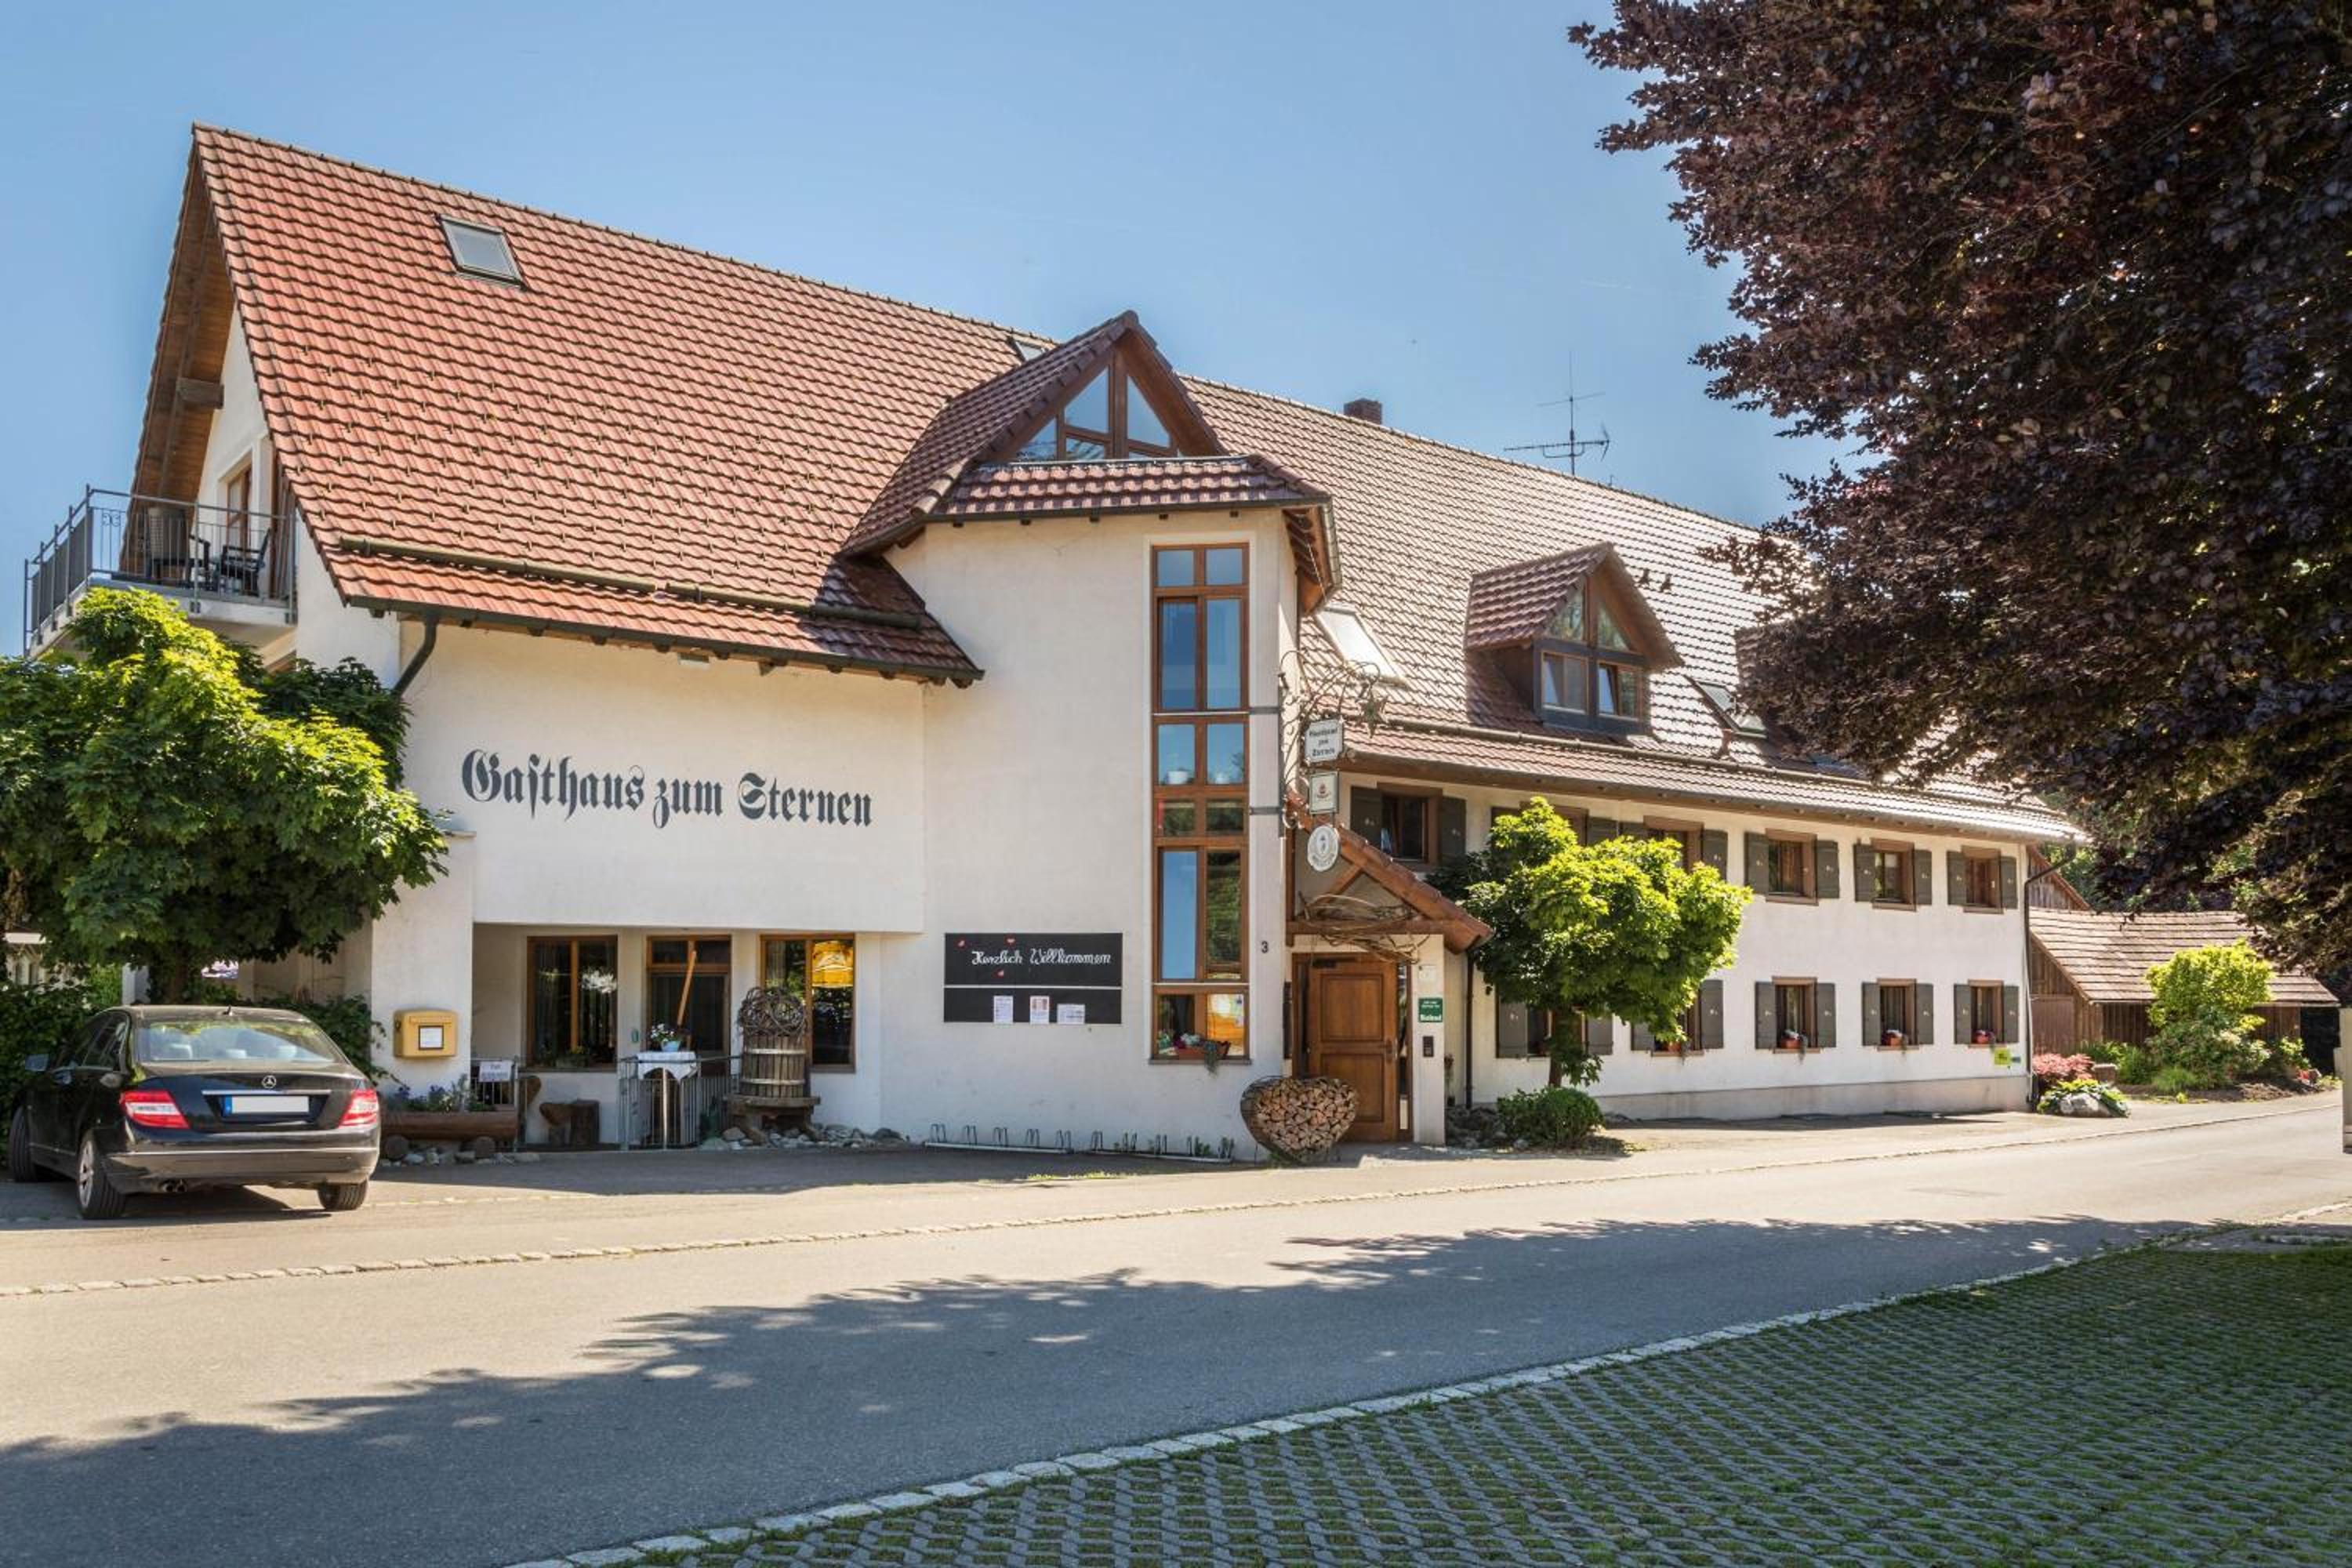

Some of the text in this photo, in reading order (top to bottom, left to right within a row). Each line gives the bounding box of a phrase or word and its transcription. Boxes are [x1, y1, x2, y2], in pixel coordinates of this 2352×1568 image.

[652, 777, 724, 829] zum
[738, 772, 873, 827] Sternen
[971, 947, 1112, 965] Herzlich Willkommen
[1261, 941, 1269, 953] 3
